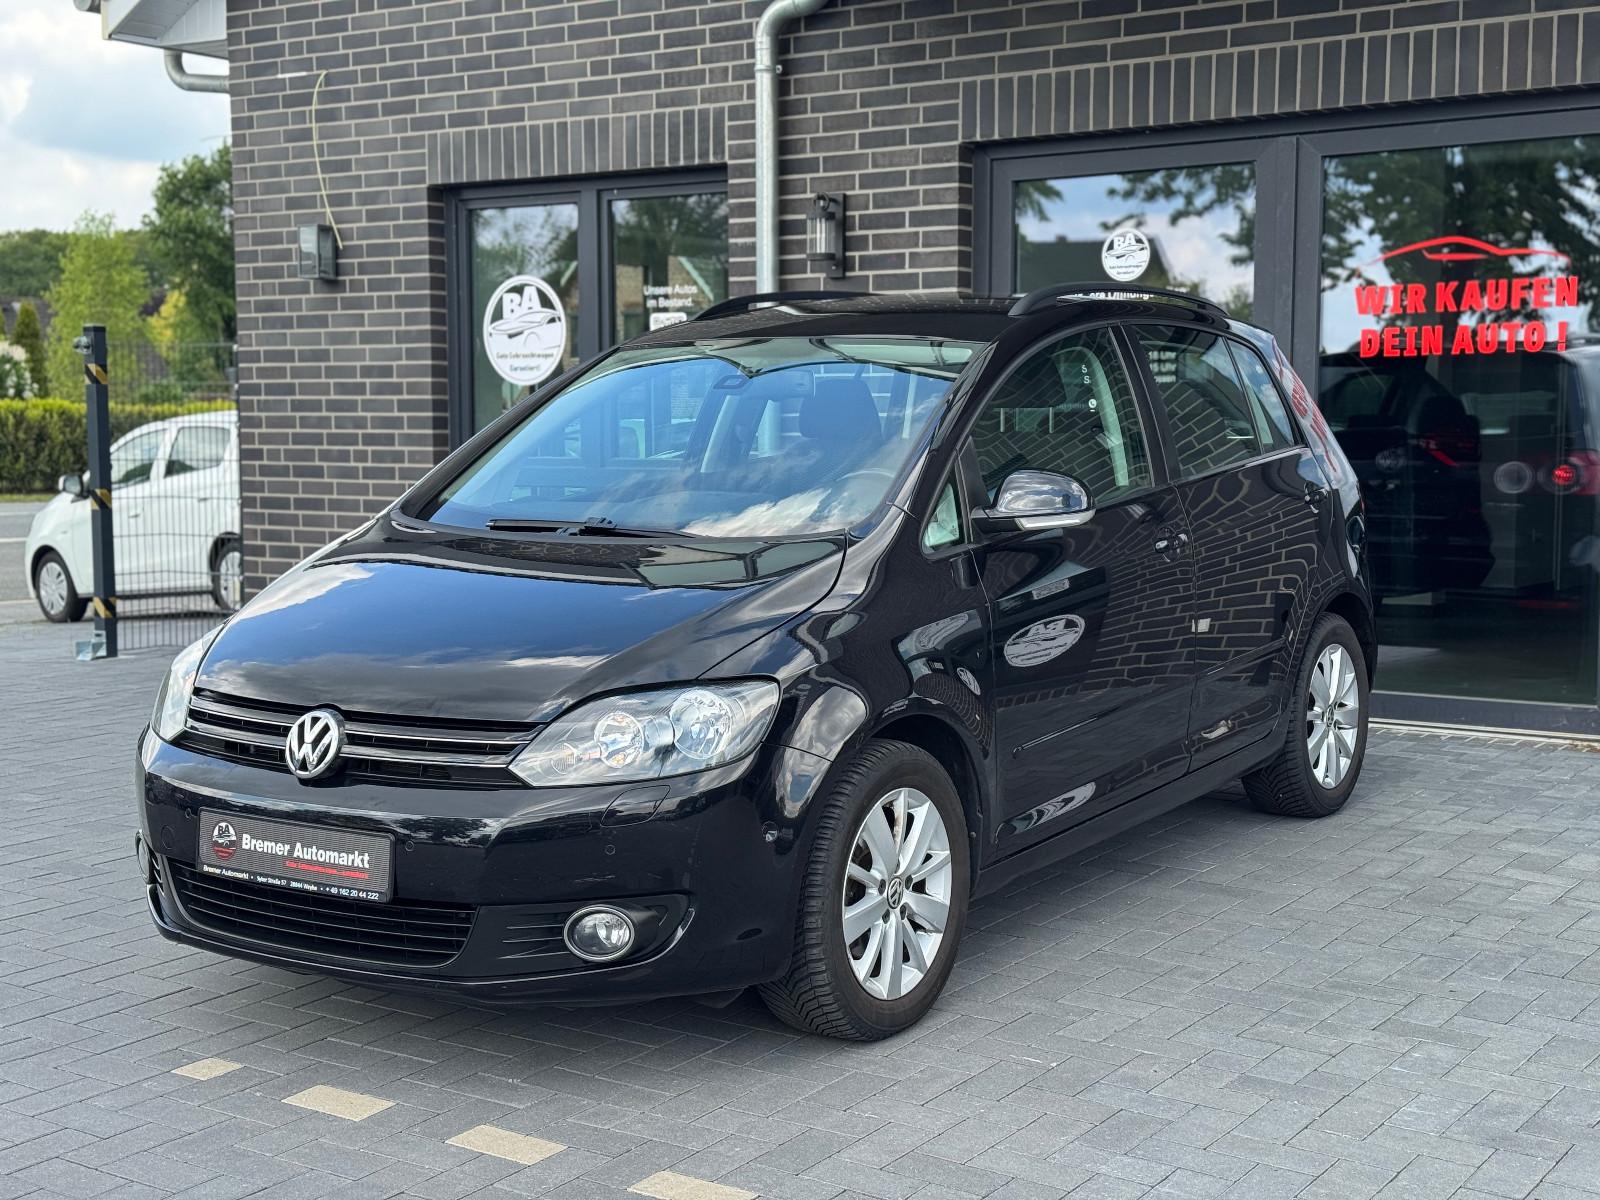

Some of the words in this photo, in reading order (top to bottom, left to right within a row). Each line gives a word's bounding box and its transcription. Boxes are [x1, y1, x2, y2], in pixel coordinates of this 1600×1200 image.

[1113, 233, 1137, 250] BA
[502, 286, 542, 319] BA
[1355, 284, 1426, 315] WIR
[1435, 276, 1578, 312] KAUFEN
[1360, 325, 1444, 358] DEIN
[1451, 321, 1546, 355] AUTO
[242, 833, 290, 856] Bremer
[293, 842, 370, 868] Automarkt
[203, 864, 221, 875] Bremer
[222, 868, 249, 880] Automarkt
[350, 889, 358, 897] 20
[359, 891, 367, 899] 44
